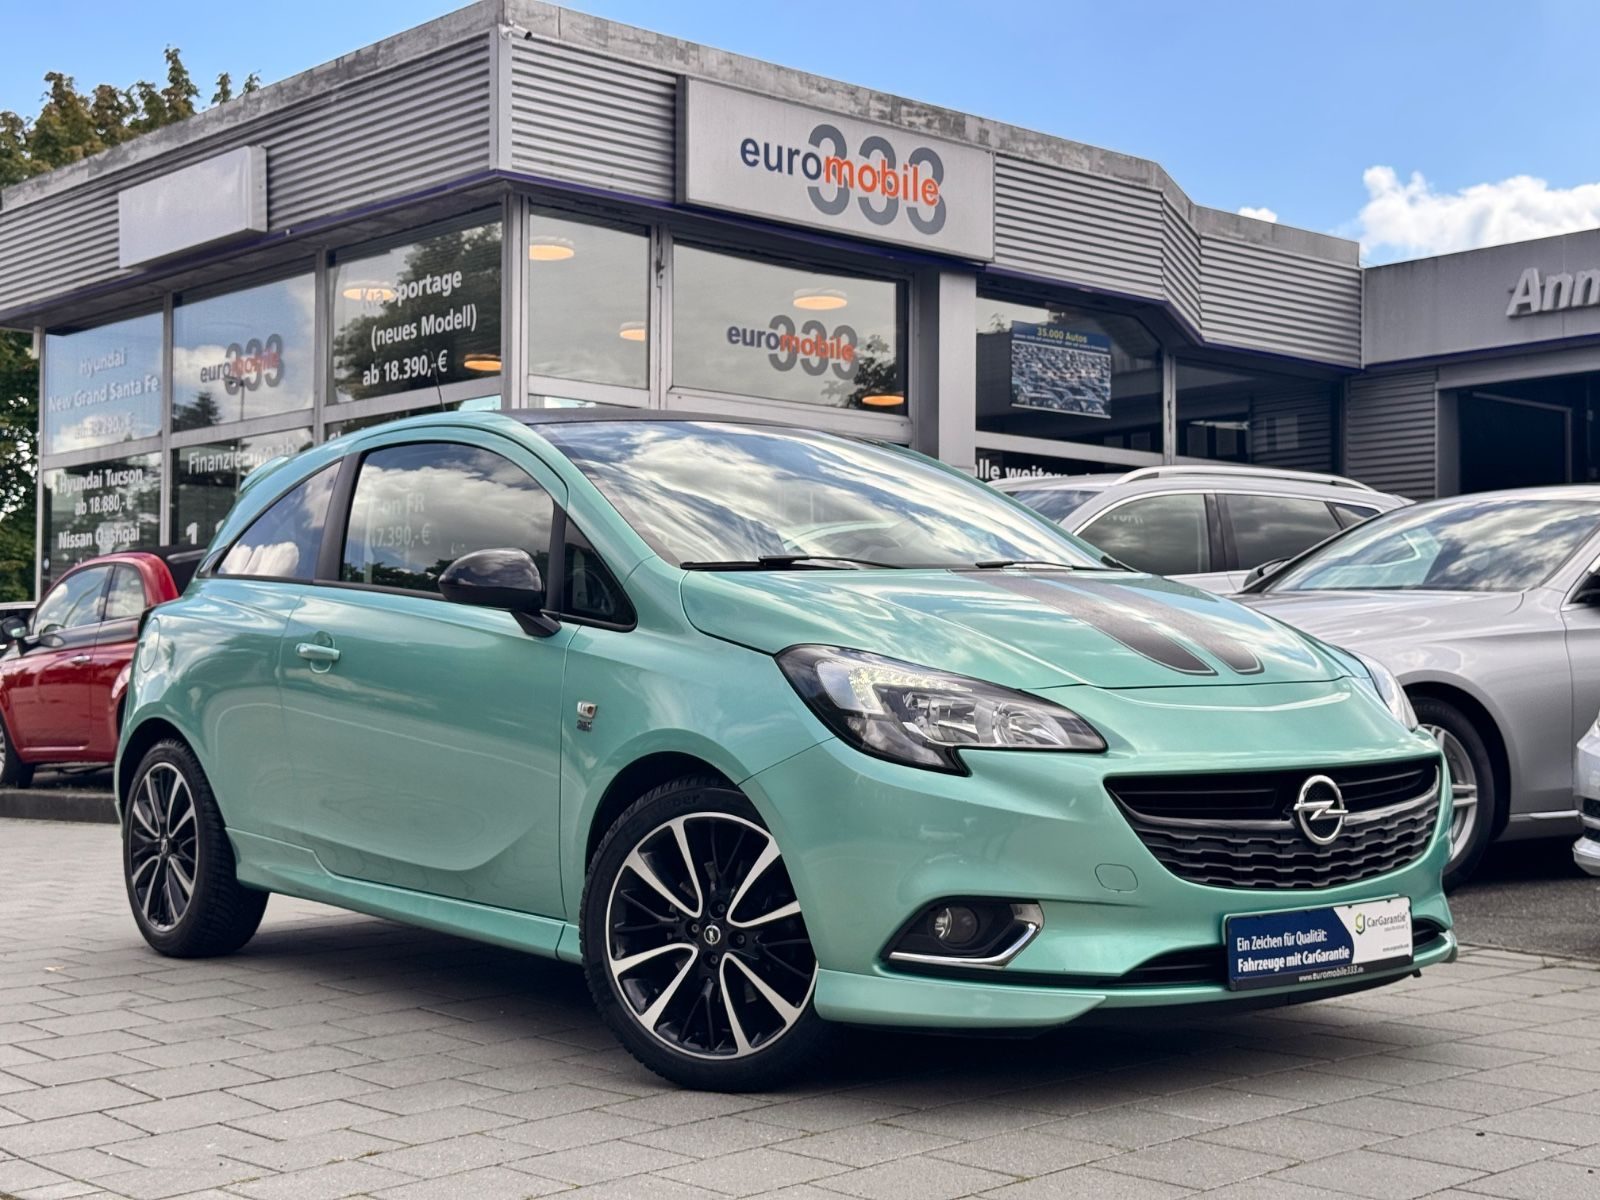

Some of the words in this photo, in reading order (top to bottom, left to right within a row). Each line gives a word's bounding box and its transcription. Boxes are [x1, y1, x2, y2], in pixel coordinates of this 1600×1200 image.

[740, 137, 939, 206] euromobile
[807, 124, 947, 235] 333
[371, 321, 417, 351] (neues
[421, 304, 477, 337] Modell)
[1036, 327, 1064, 340] 35.000
[1065, 332, 1088, 343] Autos
[727, 326, 855, 362] euromobile
[768, 315, 859, 380] 333
[80, 347, 125, 378] Hyundai
[225, 333, 285, 396] 333
[362, 363, 380, 386] ab
[384, 355, 436, 382] 18.390,-
[437, 350, 448, 372] €
[48, 395, 73, 412] New
[74, 383, 108, 407] Grand
[110, 379, 142, 401] Santa
[144, 374, 159, 393] Fe
[59, 469, 103, 498] Hyundai
[106, 468, 143, 486] Tucson
[75, 498, 87, 516] ab
[58, 530, 93, 549] Nissan
[421, 522, 432, 545] €
[1367, 912, 1406, 928] CarGarantie
[1236, 937, 1250, 952] Ein
[1251, 934, 1282, 950] Zeichen
[1283, 931, 1296, 947] für
[1296, 929, 1328, 946] Qualität:
[1237, 956, 1285, 974] Fahrzeuge
[1286, 952, 1302, 967] mit
[1302, 945, 1351, 965] CarGarantie
